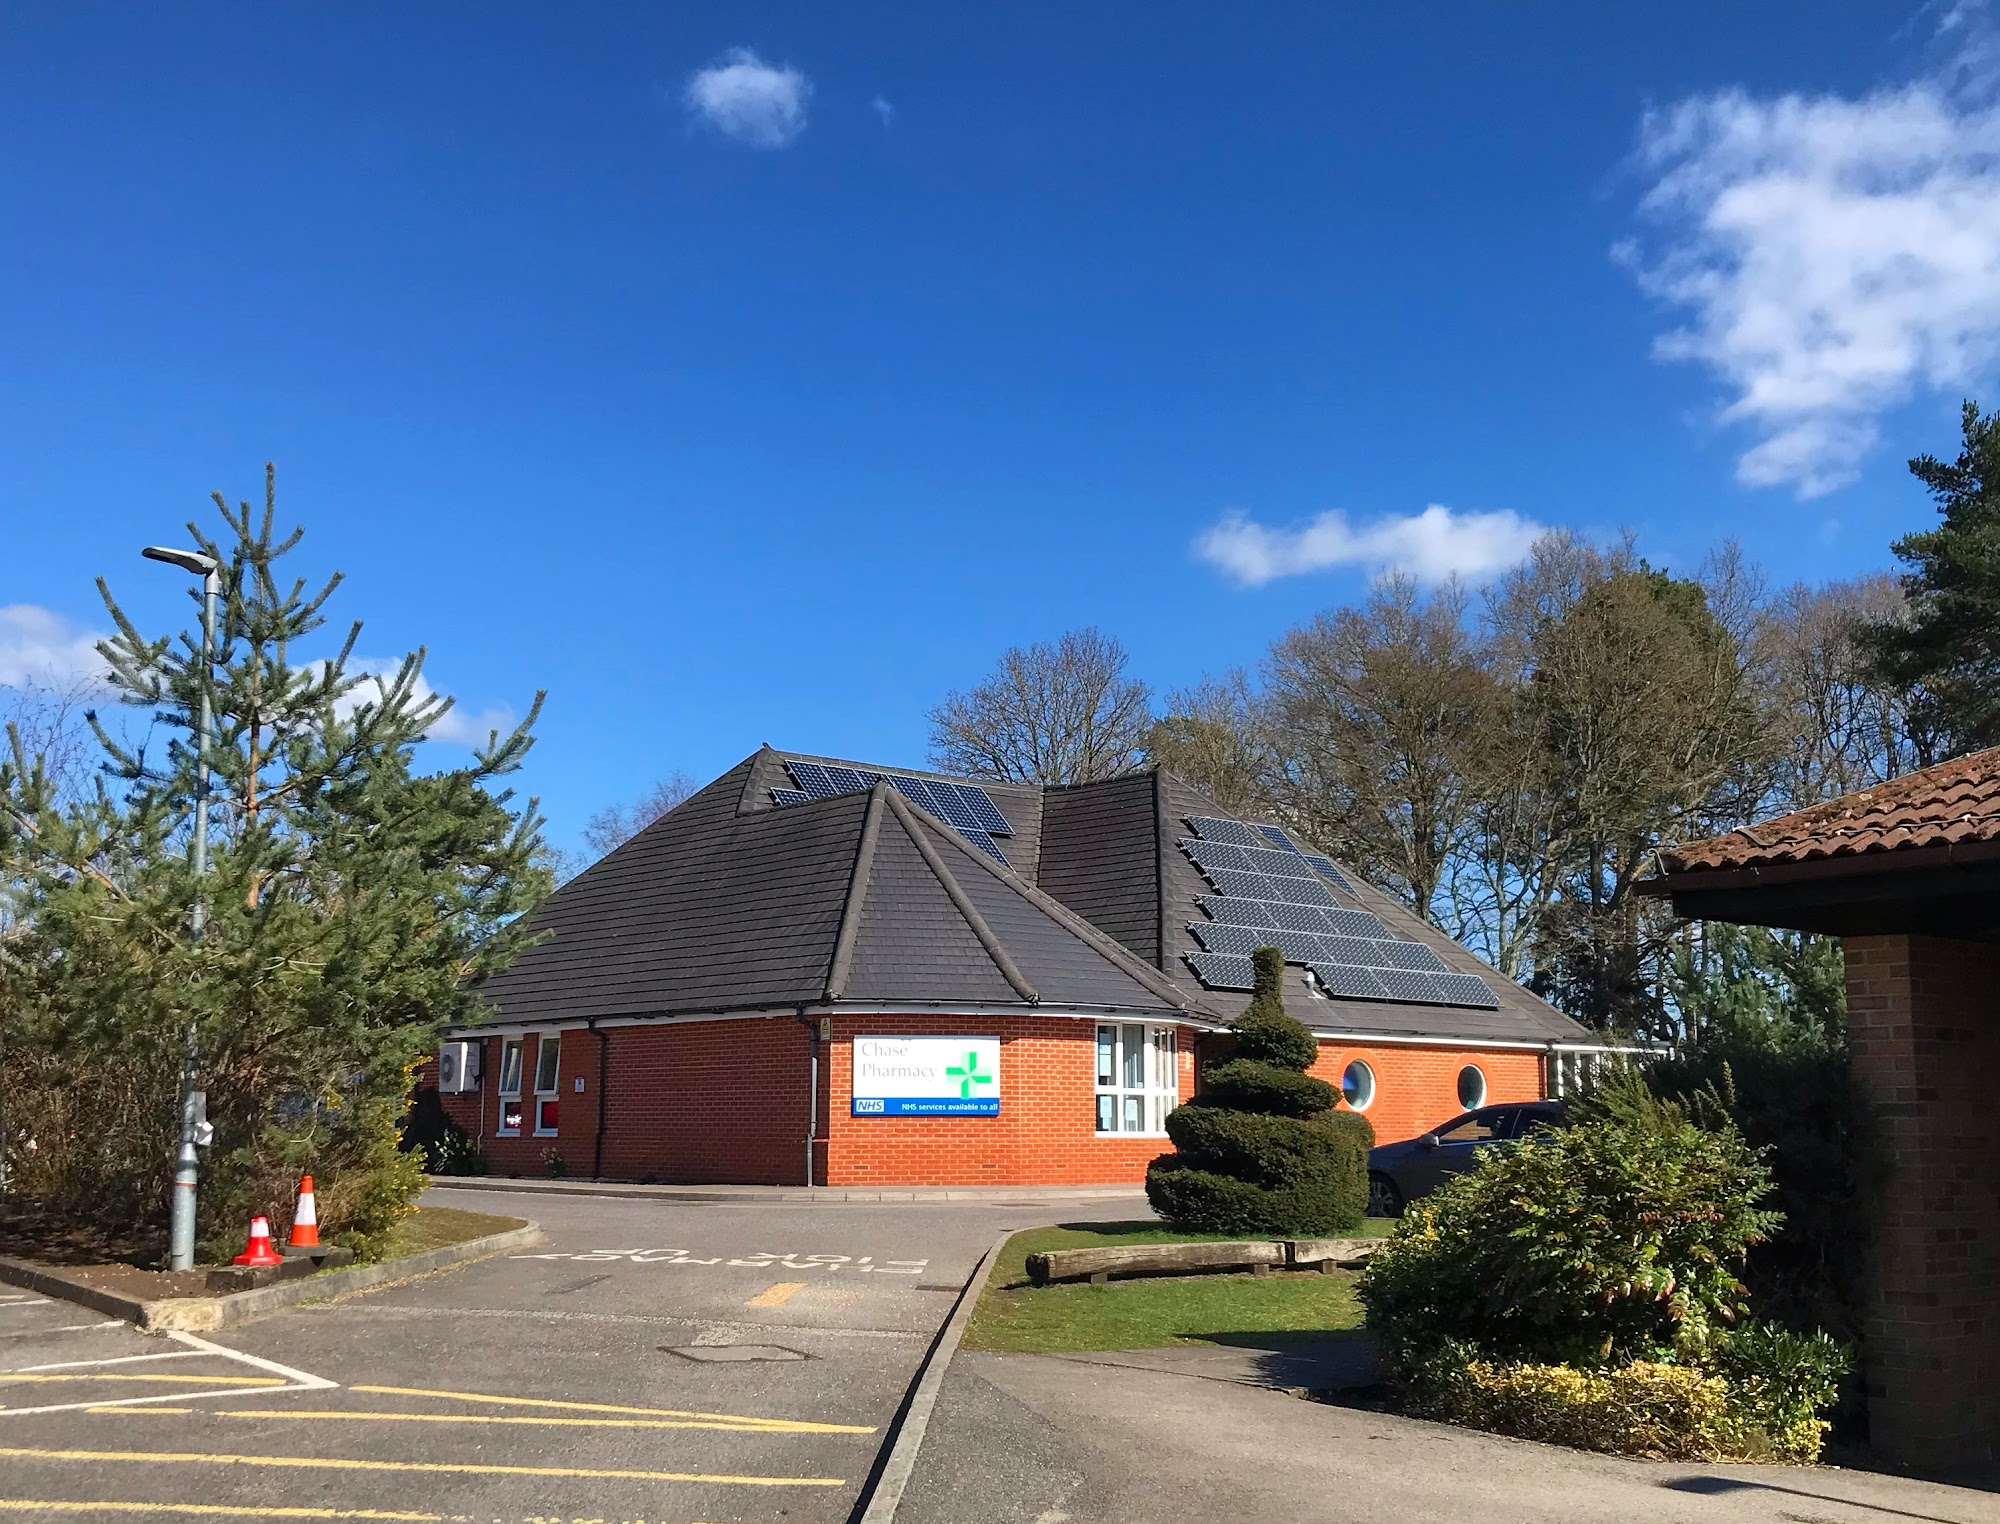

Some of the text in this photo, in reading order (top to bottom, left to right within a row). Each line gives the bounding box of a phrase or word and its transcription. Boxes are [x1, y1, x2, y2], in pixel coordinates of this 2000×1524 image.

[861, 1042, 908, 1057] Chase
[862, 1063, 937, 1082] Pharmacy
[857, 1101, 883, 1111] NHS
[948, 1103, 978, 1111] available
[989, 1103, 998, 1111] all
[591, 1248, 691, 1256] UP
[508, 1253, 925, 1274] PHARMACY
